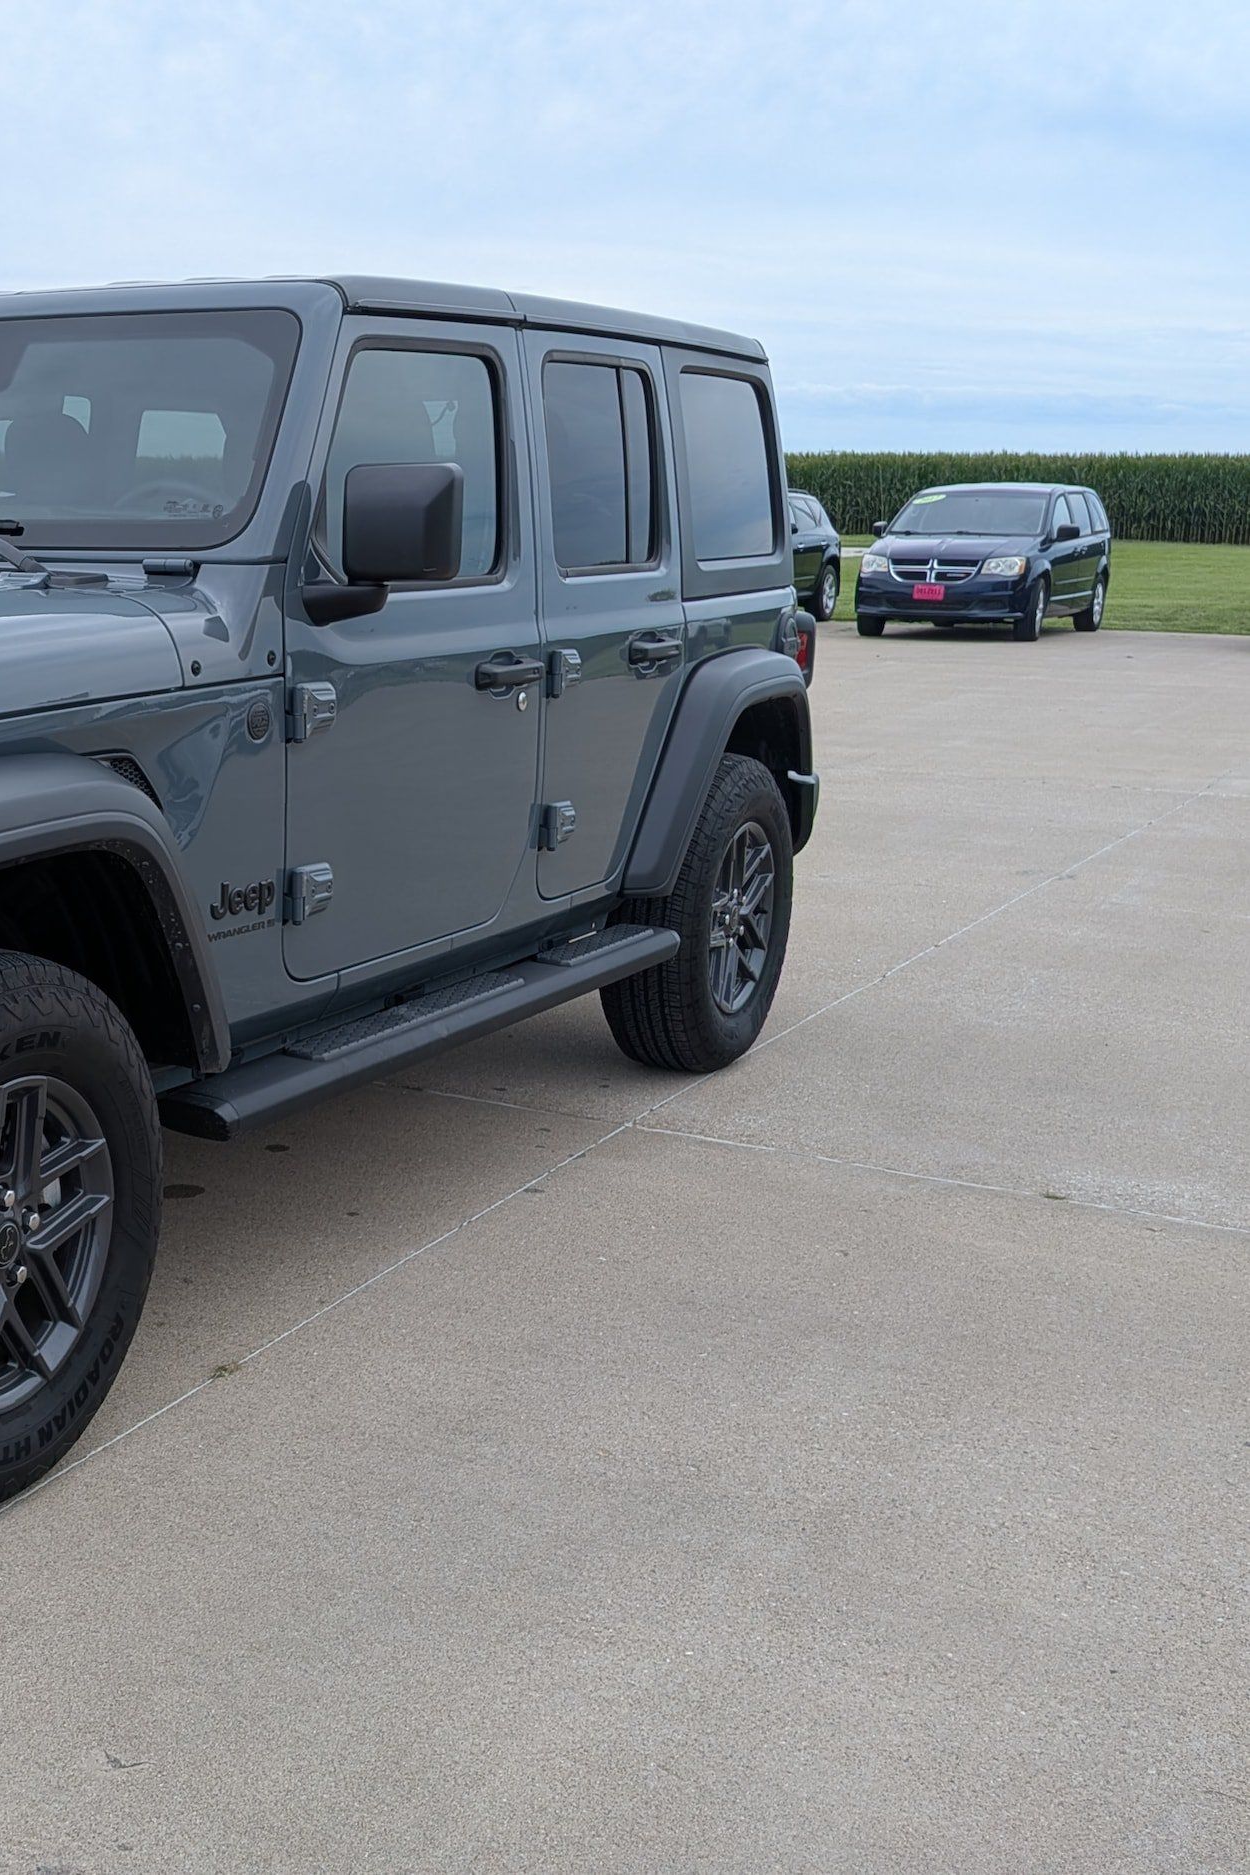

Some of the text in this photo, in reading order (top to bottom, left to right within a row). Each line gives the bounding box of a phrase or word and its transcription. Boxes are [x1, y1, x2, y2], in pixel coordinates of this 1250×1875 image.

[210, 879, 275, 920] Jeep
[207, 921, 265, 943] WRANGLER
[37, 1312, 124, 1448] ROADIAN
